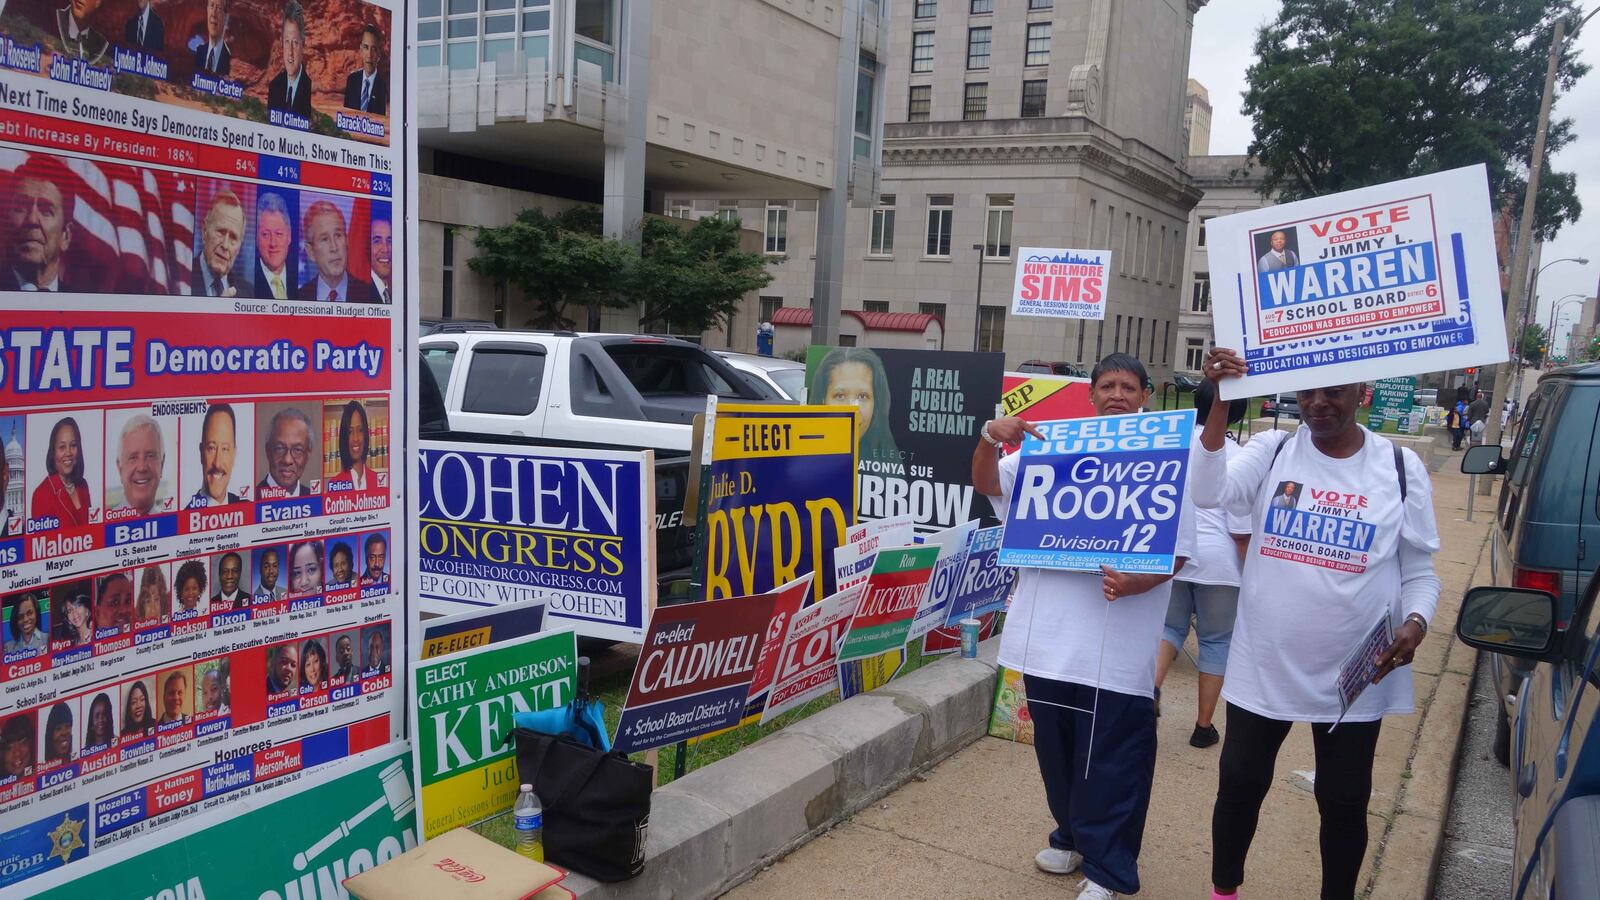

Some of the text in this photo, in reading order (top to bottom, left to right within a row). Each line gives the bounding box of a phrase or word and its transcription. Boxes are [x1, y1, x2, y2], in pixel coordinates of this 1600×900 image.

[7, 41, 40, 71] Roosevelt
[80, 61, 112, 91] Kennedy
[36, 89, 391, 171] Time Someone Says Democrats Spend Too Much, Show Them This:
[25, 124, 297, 179] Increase By President: 186% 54% 41%
[1310, 206, 1410, 238] VOTE
[1332, 226, 1390, 243] DEMOCRAT
[1318, 234, 1413, 260] JIMMY L.
[1024, 263, 1103, 277] KIM GILMORE
[1268, 245, 1426, 305] WARREN
[1021, 275, 1102, 303] SIMS
[272, 303, 334, 316] Congressional
[1035, 308, 1079, 316] ENVIRONMENTAL
[1286, 284, 1438, 321] SCHOOL BOARD DISTRICT 6
[1266, 302, 1437, 336] "EDUCATION WAS DESIGNED TO EMPOWER"
[149, 341, 381, 376] Democratic Party
[1250, 351, 1311, 372] "EDUCATION
[1313, 351, 1336, 363] WAS
[1338, 342, 1390, 358] DESIGNED
[1394, 340, 1408, 350] TO
[1411, 332, 1464, 348] EMPOWER
[912, 368, 960, 391] A REAL
[1376, 383, 1414, 391] EMPLOYEES
[152, 401, 207, 416] ENDORSEMENTS
[911, 390, 964, 413] PUBLIC
[909, 411, 975, 436] SERVANT
[1031, 415, 1185, 442] RE-ELECT
[743, 424, 792, 451] ELECT
[1028, 434, 1182, 455] JUDGE
[873, 448, 916, 460] ELECT
[910, 465, 933, 478] SUE
[1071, 457, 1181, 484] Gwen
[708, 471, 756, 505] Julie D.
[1015, 464, 1177, 521] ROOKS
[1311, 488, 1368, 508] VOTE
[190, 496, 207, 510] Joe
[261, 503, 311, 522] Evans
[325, 494, 386, 514] Corbin-Johnson
[1308, 504, 1351, 517] JIMMY
[28, 517, 59, 532] Deidre
[106, 508, 136, 520] Gordon
[189, 509, 243, 532] Brown
[115, 521, 157, 544] Ball
[851, 531, 864, 543] VOTE
[1039, 524, 1157, 552] Division 12
[1271, 508, 1371, 550] WARREN
[32, 533, 93, 560] Malone
[132, 544, 157, 554] Senate
[420, 523, 623, 576] ONGRESS
[707, 497, 847, 604] BYRD
[859, 536, 879, 554] ELECT
[1270, 537, 1367, 563] 7 SCHOOL BOARD 6
[46, 559, 73, 571] Mayor
[122, 556, 145, 567] Clerks
[900, 553, 916, 568] Ron
[1007, 552, 1160, 565] General Sessions Court
[1261, 547, 1292, 560] "EDUCATION
[1293, 554, 1305, 562] WAS
[1306, 556, 1326, 566] DESIGN
[1336, 562, 1365, 573] EMPOWER"
[838, 564, 854, 579] KYLE
[9, 576, 41, 590] Judicial
[361, 587, 388, 597] DeBerry
[992, 586, 1006, 601] 12
[252, 595, 268, 604] Joe
[291, 598, 320, 612] Akbari
[326, 593, 357, 603] Cooper
[443, 579, 623, 619] GOIN' COHEN!
[213, 613, 246, 627] Dixon
[253, 607, 276, 619] Towns
[135, 628, 168, 645] Draper
[172, 621, 207, 636] Jackson
[653, 623, 695, 646] re-elect
[95, 637, 130, 655] Thompson
[193, 632, 298, 660] Democratic Executive Committee
[428, 632, 484, 657] RE-ELECT
[4, 649, 36, 663] Christine
[639, 633, 758, 694] CALDWELL
[9, 661, 41, 678] Cane
[425, 662, 467, 685] ELECT
[362, 677, 389, 693] Cobb
[418, 655, 572, 710] CATHY ANDERSON-
[772, 689, 789, 705] For
[790, 680, 809, 693] Our
[300, 694, 327, 709] Carson
[332, 686, 354, 701] Gill
[268, 702, 295, 718] Carson
[634, 713, 667, 736] School
[667, 706, 696, 728] Board
[695, 701, 727, 721] District
[197, 719, 227, 736] Lowery
[157, 729, 192, 749] Thompson
[120, 741, 155, 761] Brownlee
[215, 739, 272, 763] Honorees
[81, 752, 116, 774] Austin
[255, 754, 301, 777] Aderson-Kent
[41, 766, 73, 789] Love
[165, 774, 194, 790] Nathan
[206, 770, 250, 793] Martin-Andrews
[156, 789, 193, 808] Toney
[99, 806, 140, 827] Ross
[426, 799, 489, 832] General Sessions
